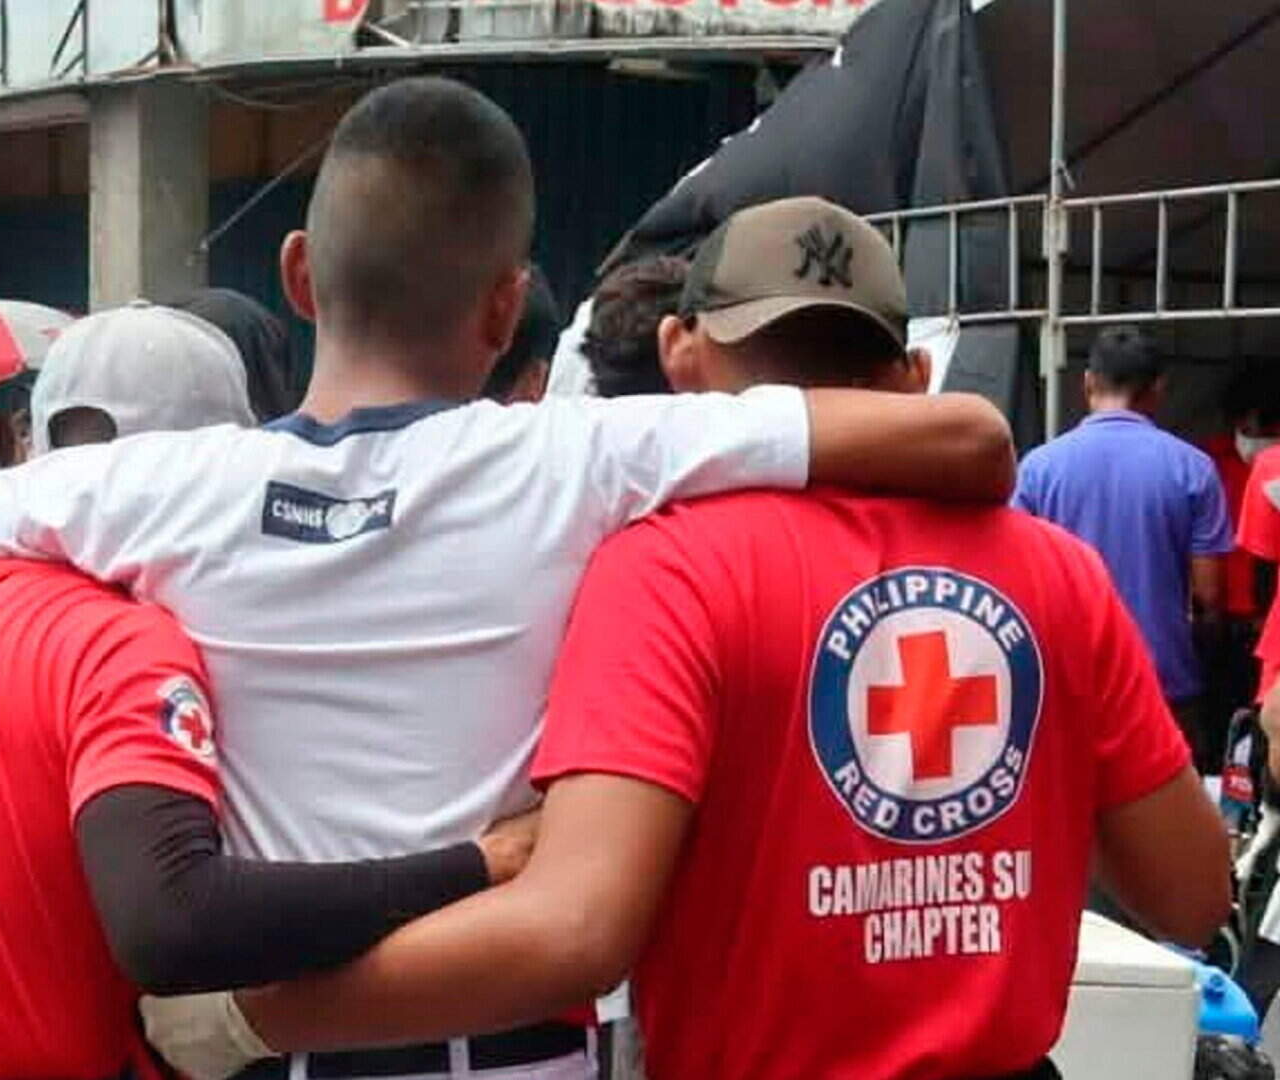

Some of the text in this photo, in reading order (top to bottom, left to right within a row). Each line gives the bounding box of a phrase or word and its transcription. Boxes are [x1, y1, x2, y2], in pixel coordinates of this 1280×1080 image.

[834, 746, 1023, 835] RED CROSS
[808, 852, 984, 917] CAMARINES
[865, 903, 1002, 965] CHAPTER
